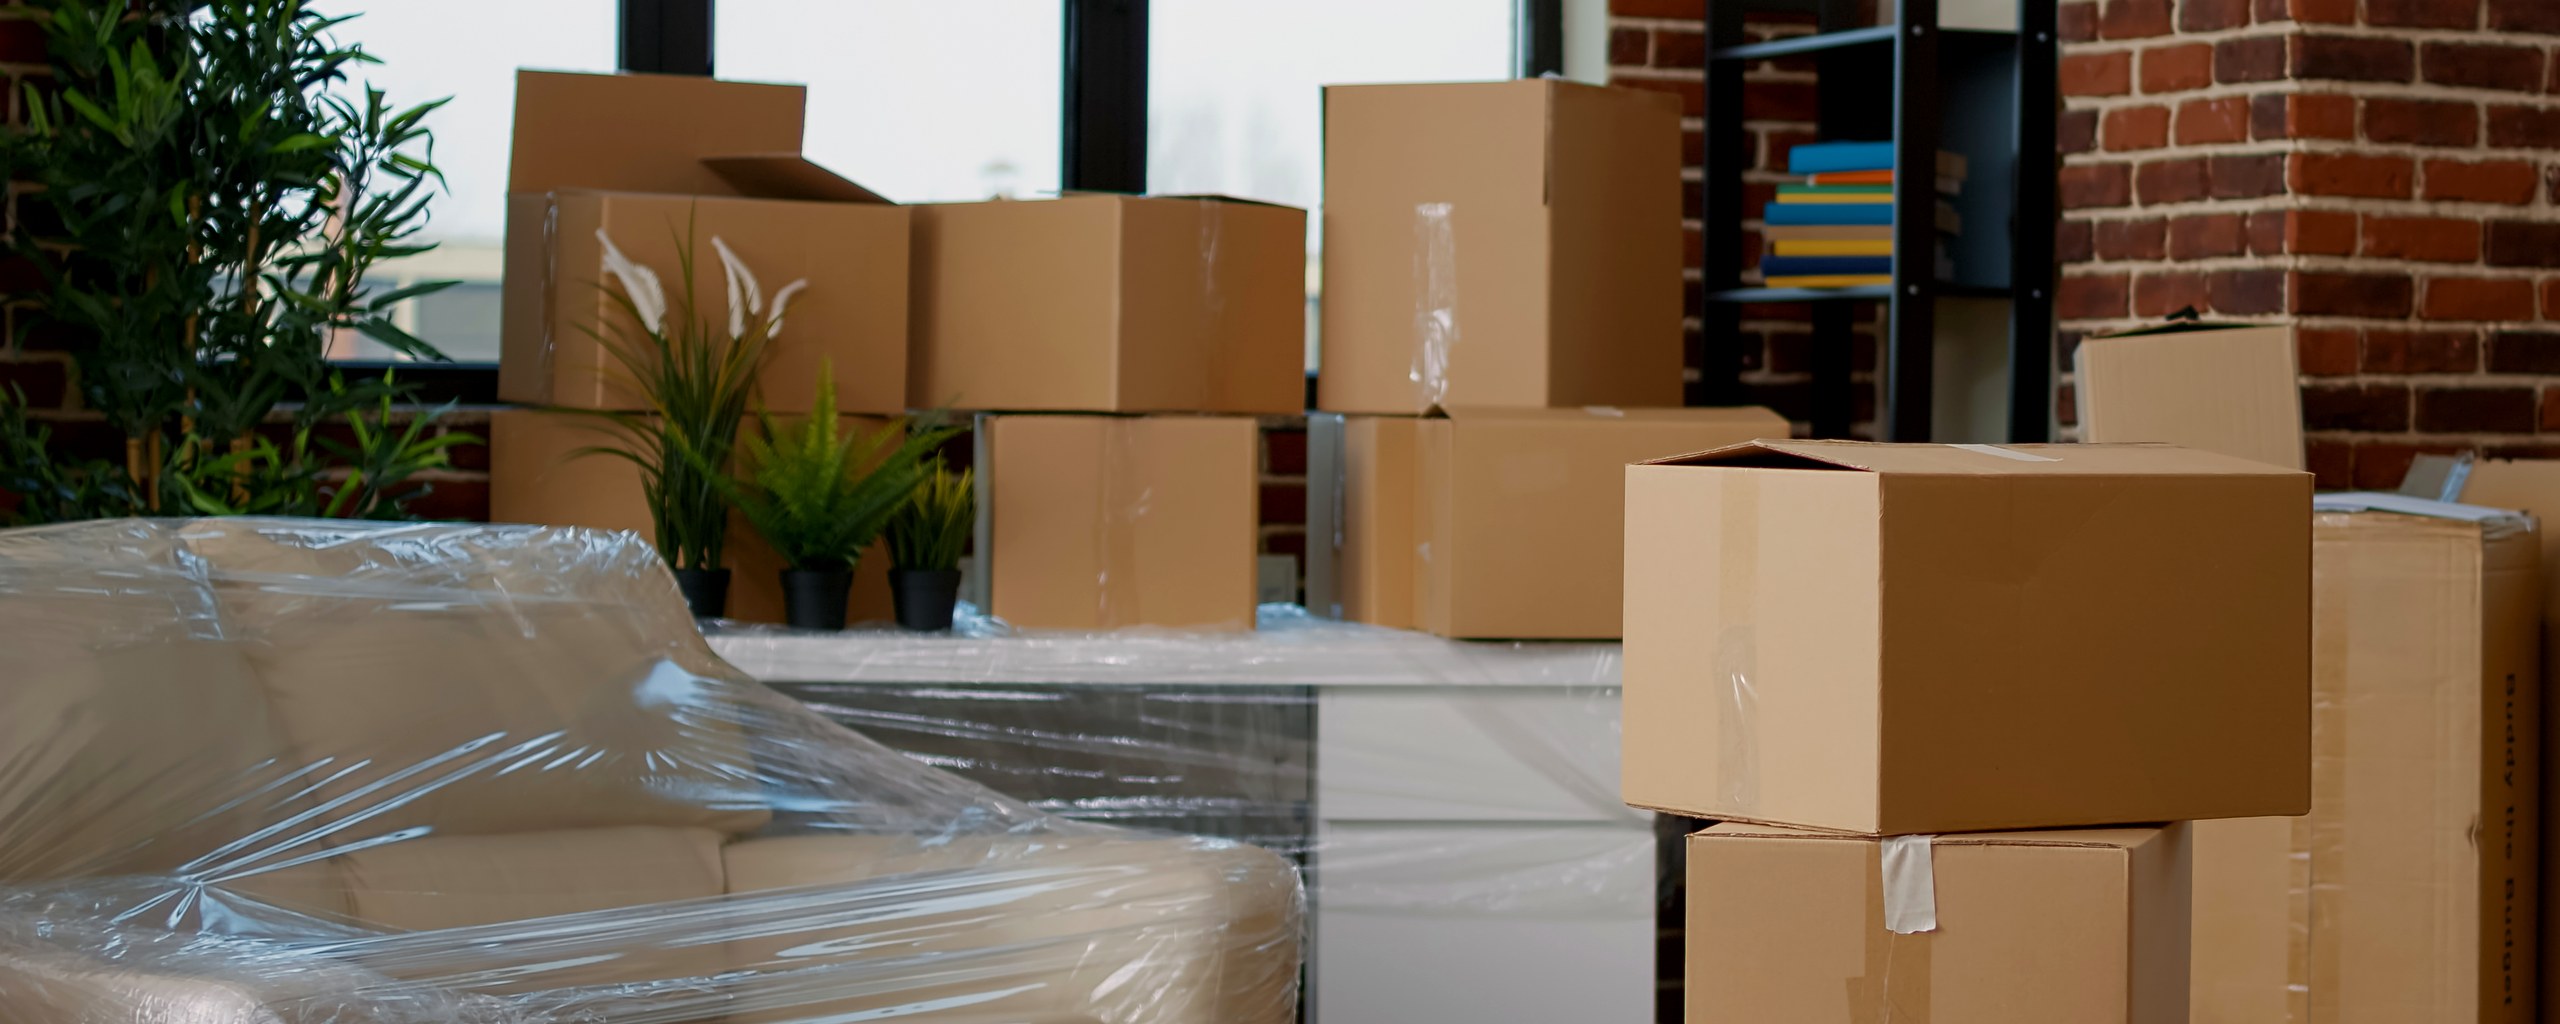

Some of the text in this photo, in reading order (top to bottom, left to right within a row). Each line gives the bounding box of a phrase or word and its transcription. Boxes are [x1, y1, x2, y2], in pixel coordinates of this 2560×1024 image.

[2503, 673, 2516, 1006] Buddy the Budget
